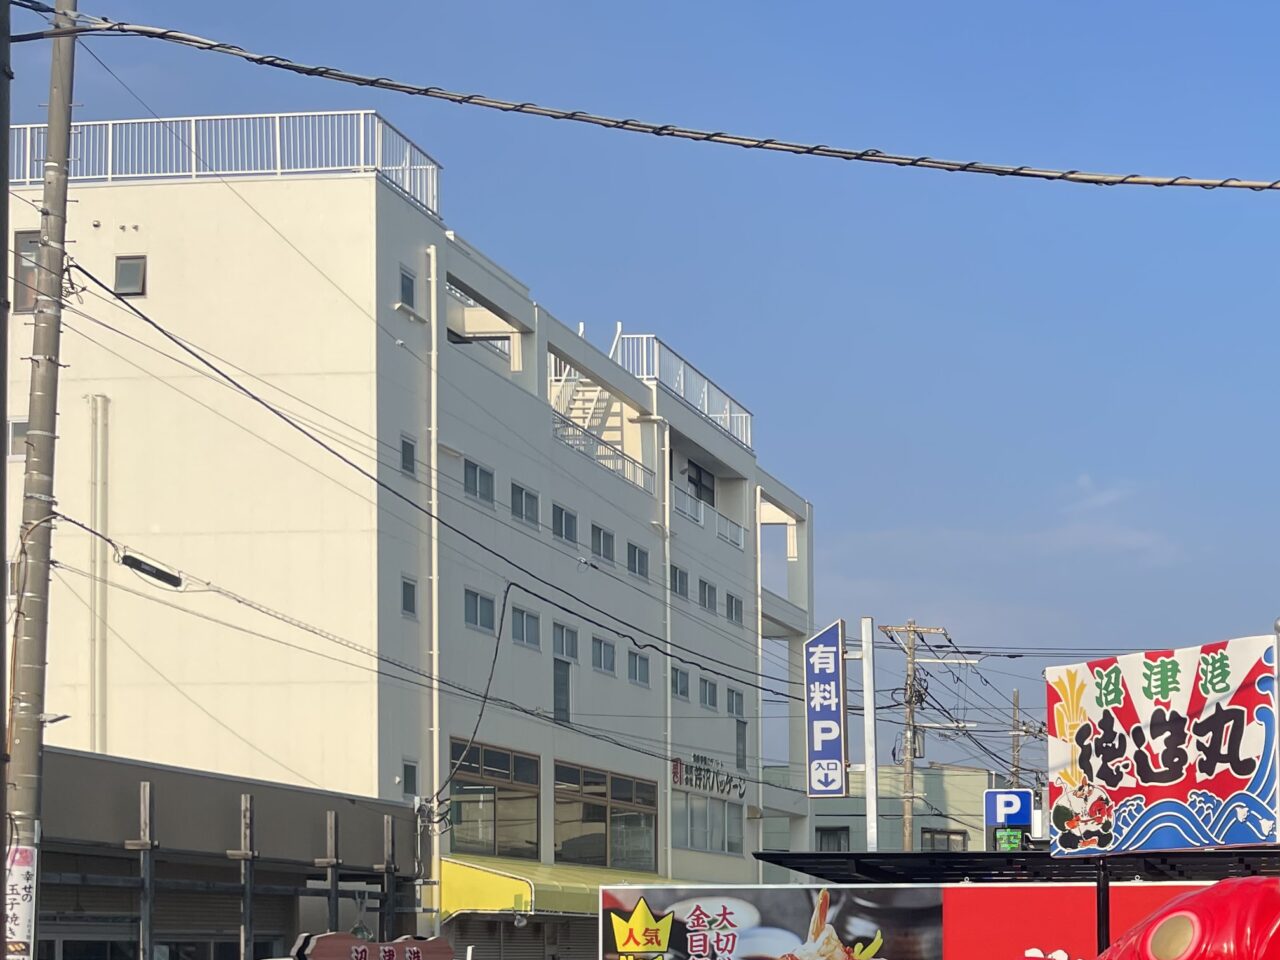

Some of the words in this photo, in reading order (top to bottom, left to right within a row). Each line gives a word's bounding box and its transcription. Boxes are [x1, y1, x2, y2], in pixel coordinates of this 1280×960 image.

[1094, 651, 1232, 708] 沼津港
[808, 644, 840, 752] 有料P
[814, 761, 839, 772] 入口
[996, 793, 1021, 823] P
[21, 870, 34, 903] 幸せの
[621, 926, 662, 948] 人気
